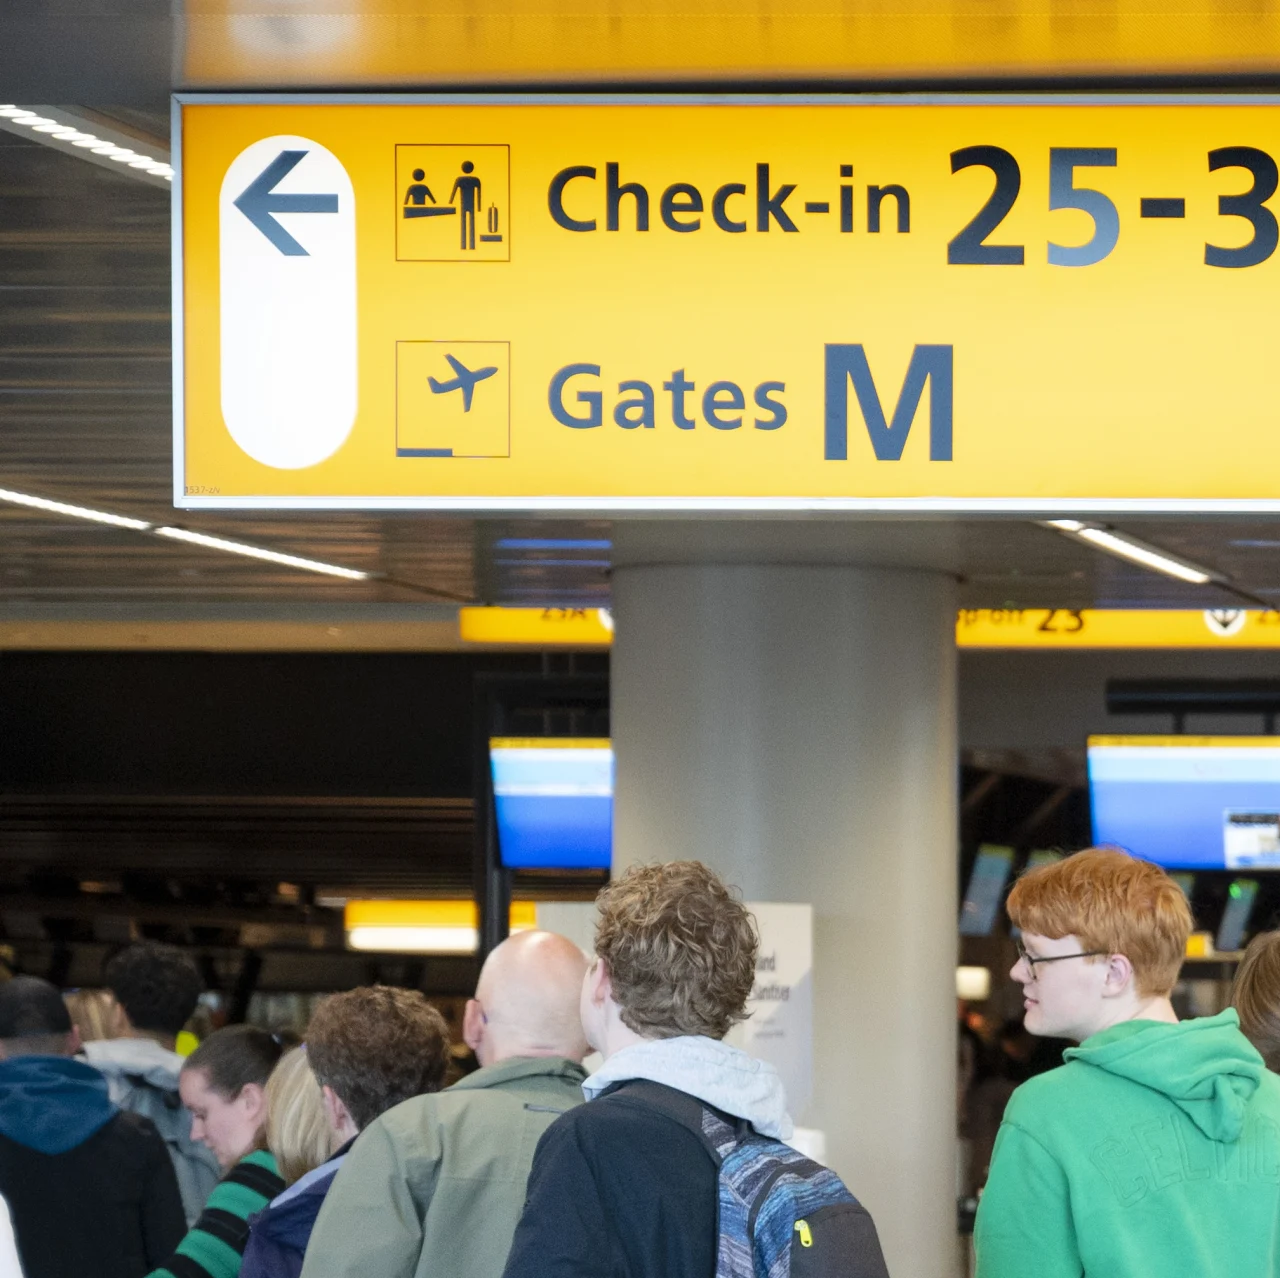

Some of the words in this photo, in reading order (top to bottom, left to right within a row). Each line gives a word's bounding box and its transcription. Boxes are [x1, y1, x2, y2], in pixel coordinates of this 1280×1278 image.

[549, 163, 910, 233] Check-in
[549, 363, 788, 431] Gates
[824, 344, 954, 462] M
